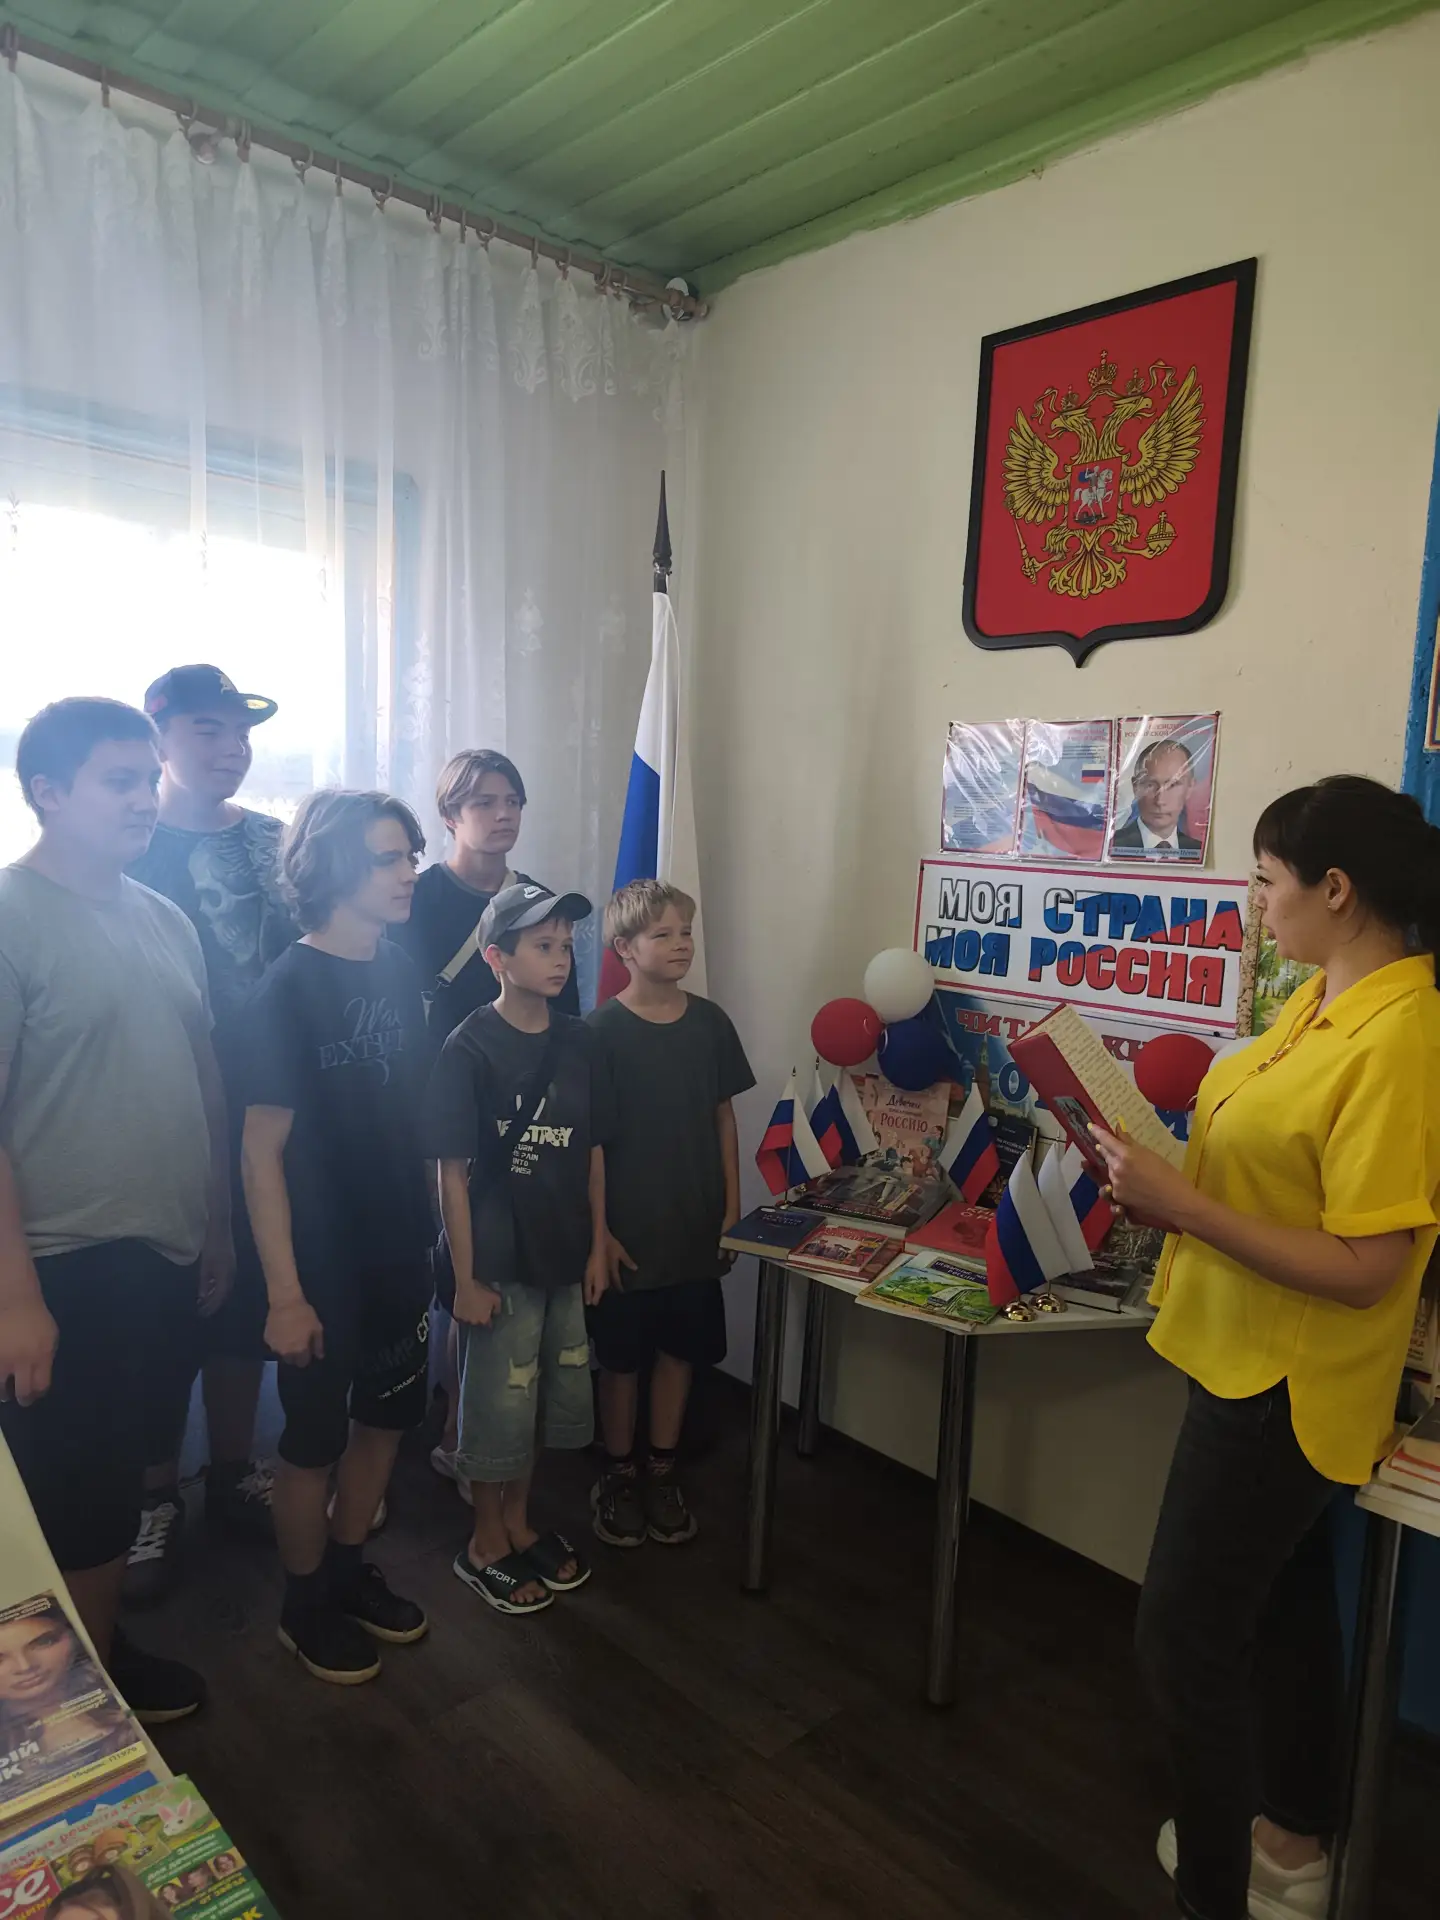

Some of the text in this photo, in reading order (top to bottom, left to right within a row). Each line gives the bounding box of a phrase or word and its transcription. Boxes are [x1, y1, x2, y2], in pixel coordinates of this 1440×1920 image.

[938, 877, 1244, 952] МОЯ СТРАНА
[924, 924, 1226, 1008] МОЯ РОССИЯ
[955, 1007, 1038, 1041] ЧИТ
[880, 1112, 928, 1133] РОССИЮ
[484, 1566, 518, 1587] SPORT
